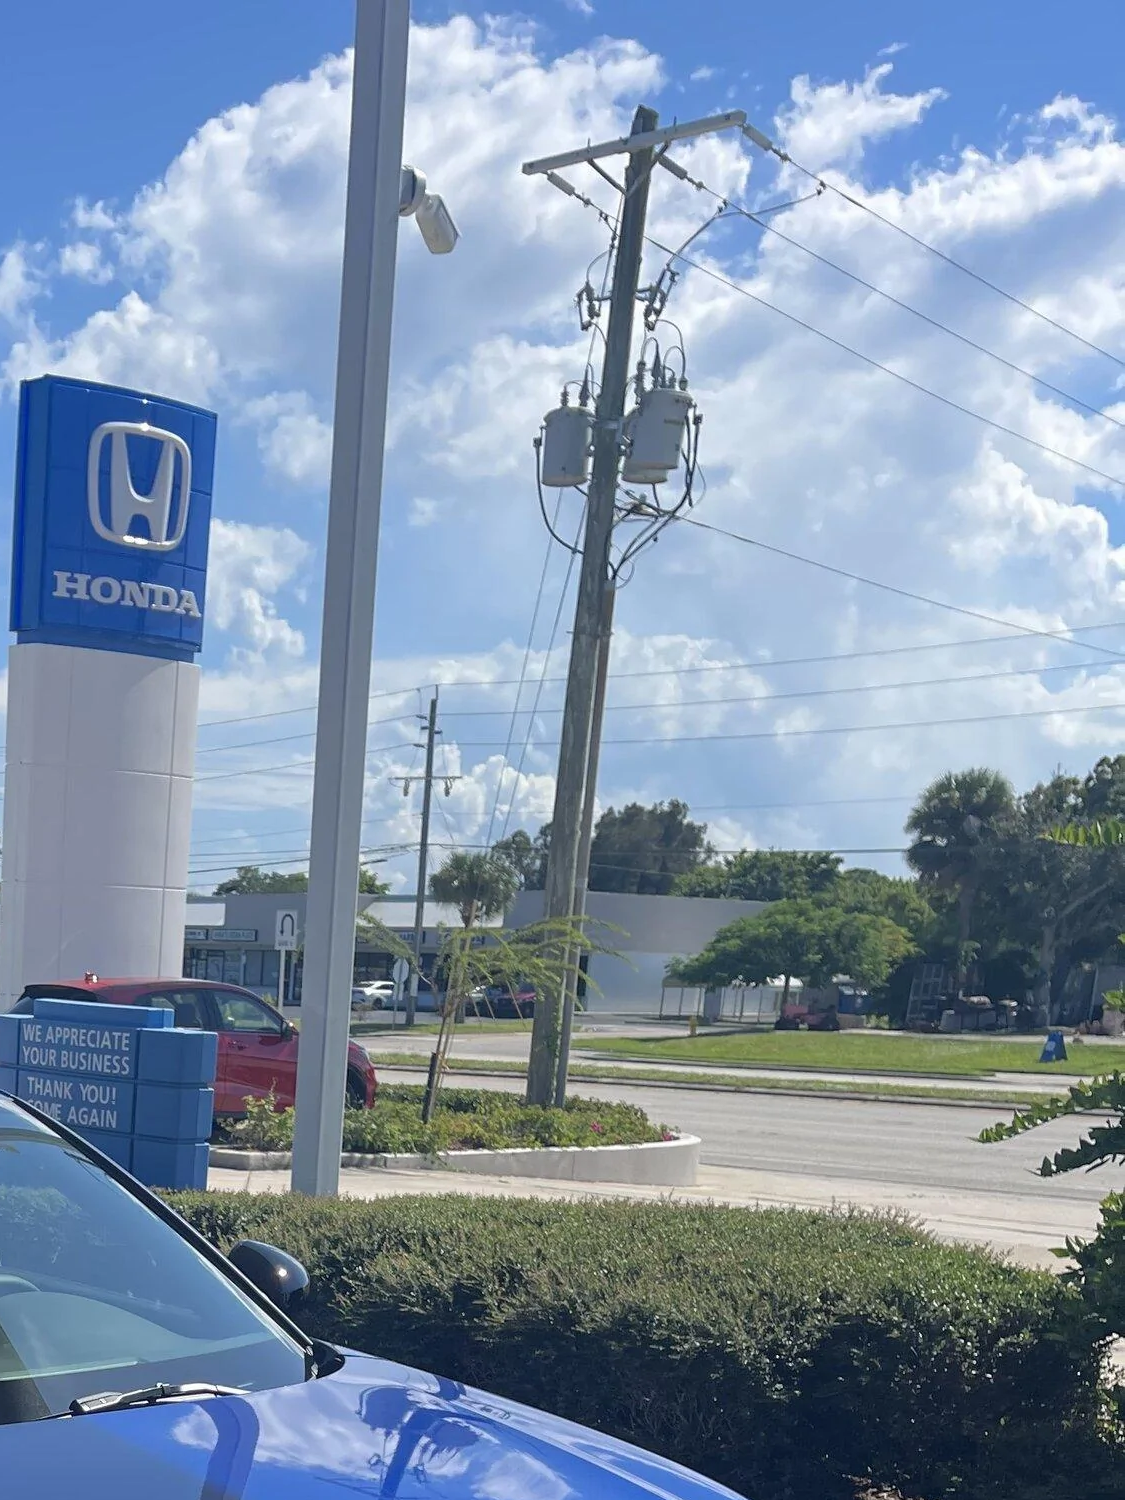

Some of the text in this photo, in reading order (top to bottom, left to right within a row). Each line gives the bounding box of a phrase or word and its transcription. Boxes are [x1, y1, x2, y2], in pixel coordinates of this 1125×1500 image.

[52, 570, 202, 618] HONDA
[22, 1023, 131, 1051] WE APPRECIATE
[22, 1046, 130, 1075] YOUR BUSINESS
[27, 1076, 117, 1105] THANK YOU!
[29, 1099, 117, 1129] OME AGAIN
